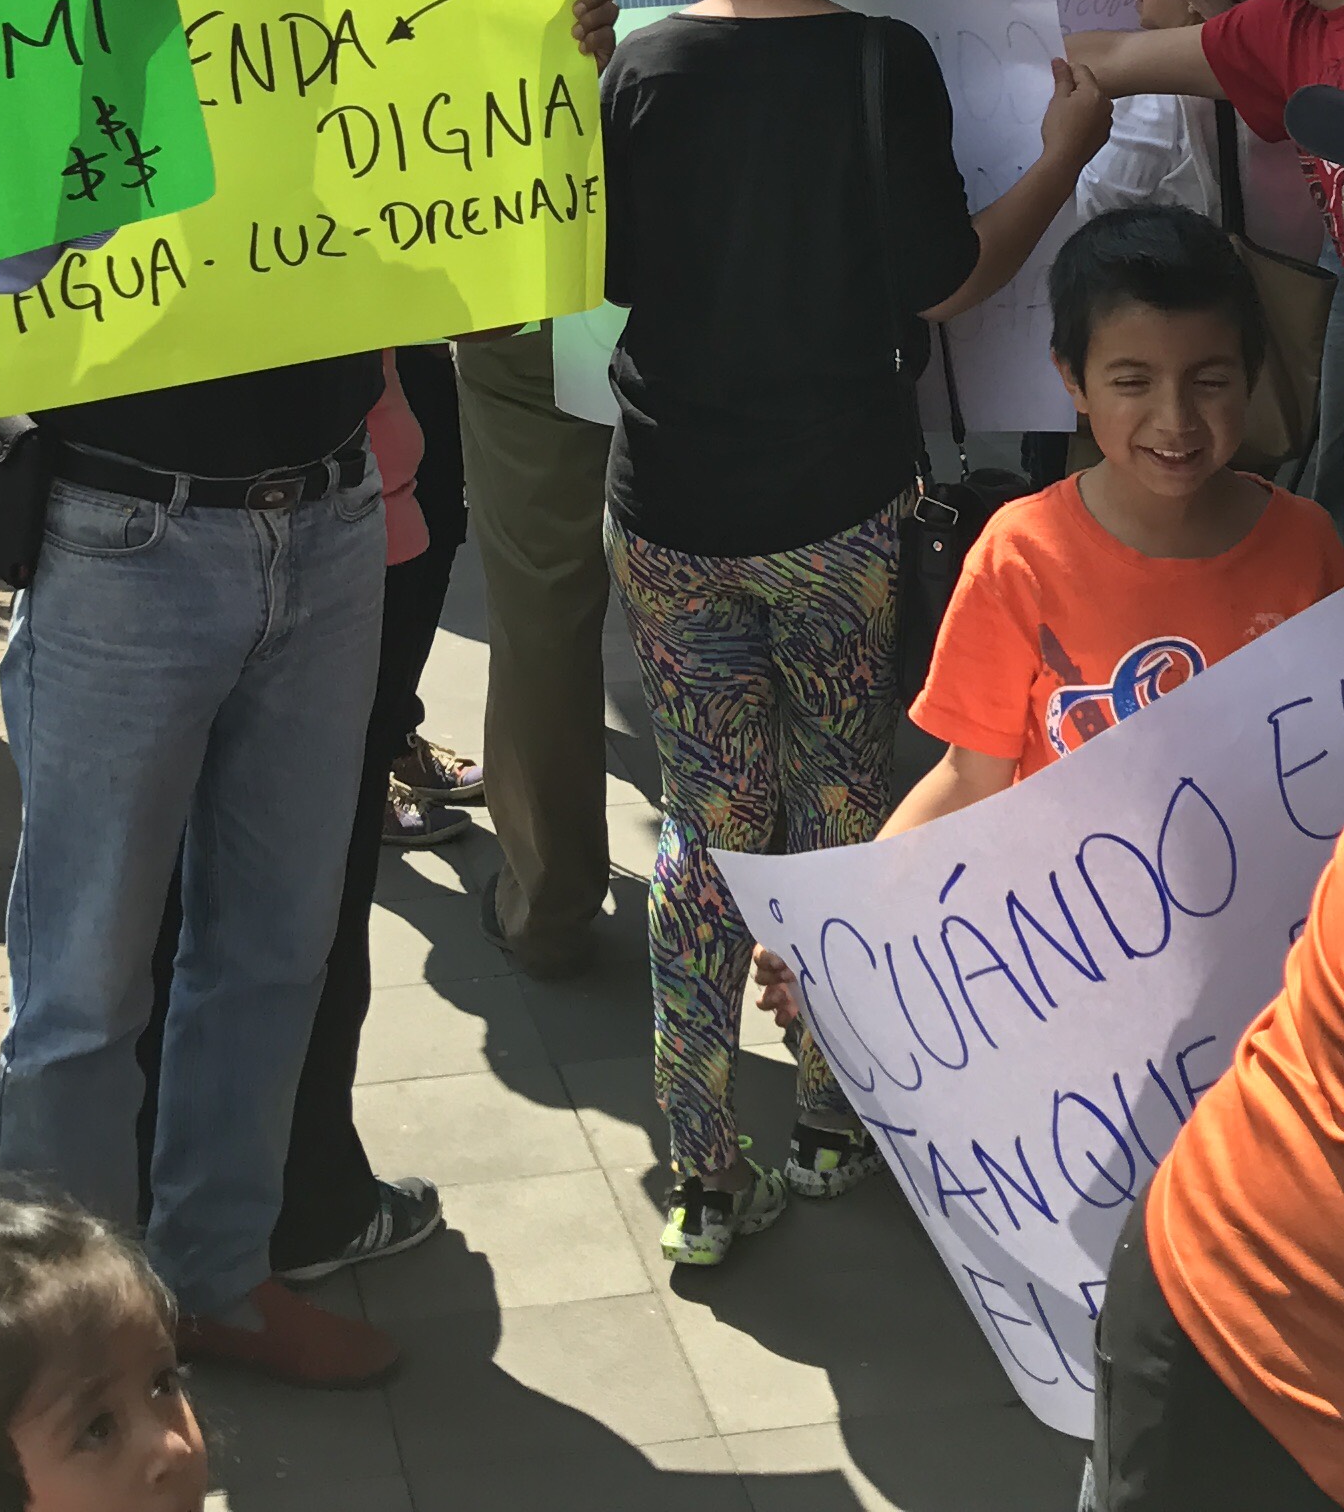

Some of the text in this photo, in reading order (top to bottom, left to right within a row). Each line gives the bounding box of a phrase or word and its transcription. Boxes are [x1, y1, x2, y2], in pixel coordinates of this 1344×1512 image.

[186, 8, 377, 106] ENDA
[316, 73, 584, 178] DIGNA
[380, 173, 600, 251] DRENAJE
